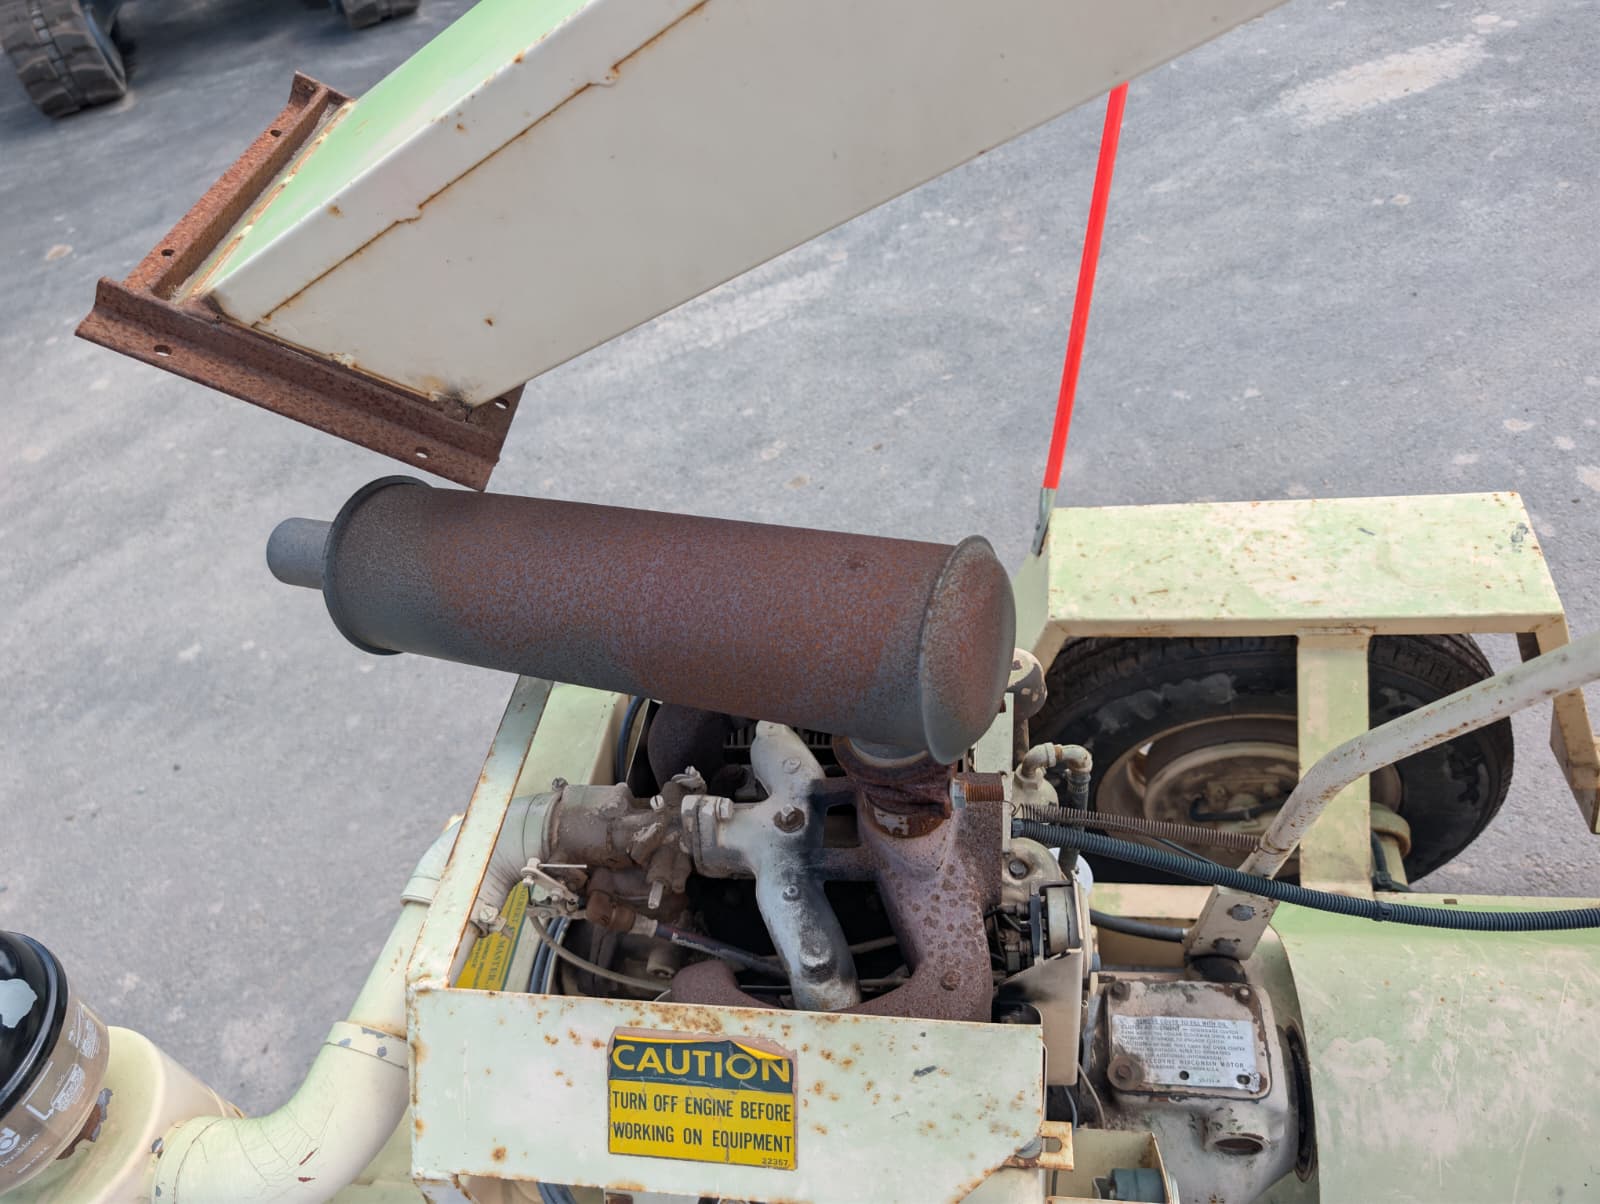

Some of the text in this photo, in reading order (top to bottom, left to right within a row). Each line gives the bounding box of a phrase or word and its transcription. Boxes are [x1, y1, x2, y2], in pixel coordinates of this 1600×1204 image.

[612, 1044, 790, 1083] CAUTION
[612, 1091, 791, 1122] TURN OFF ENGINE BEFORE
[612, 1121, 792, 1153] WORKING ON EQUIPMENT
